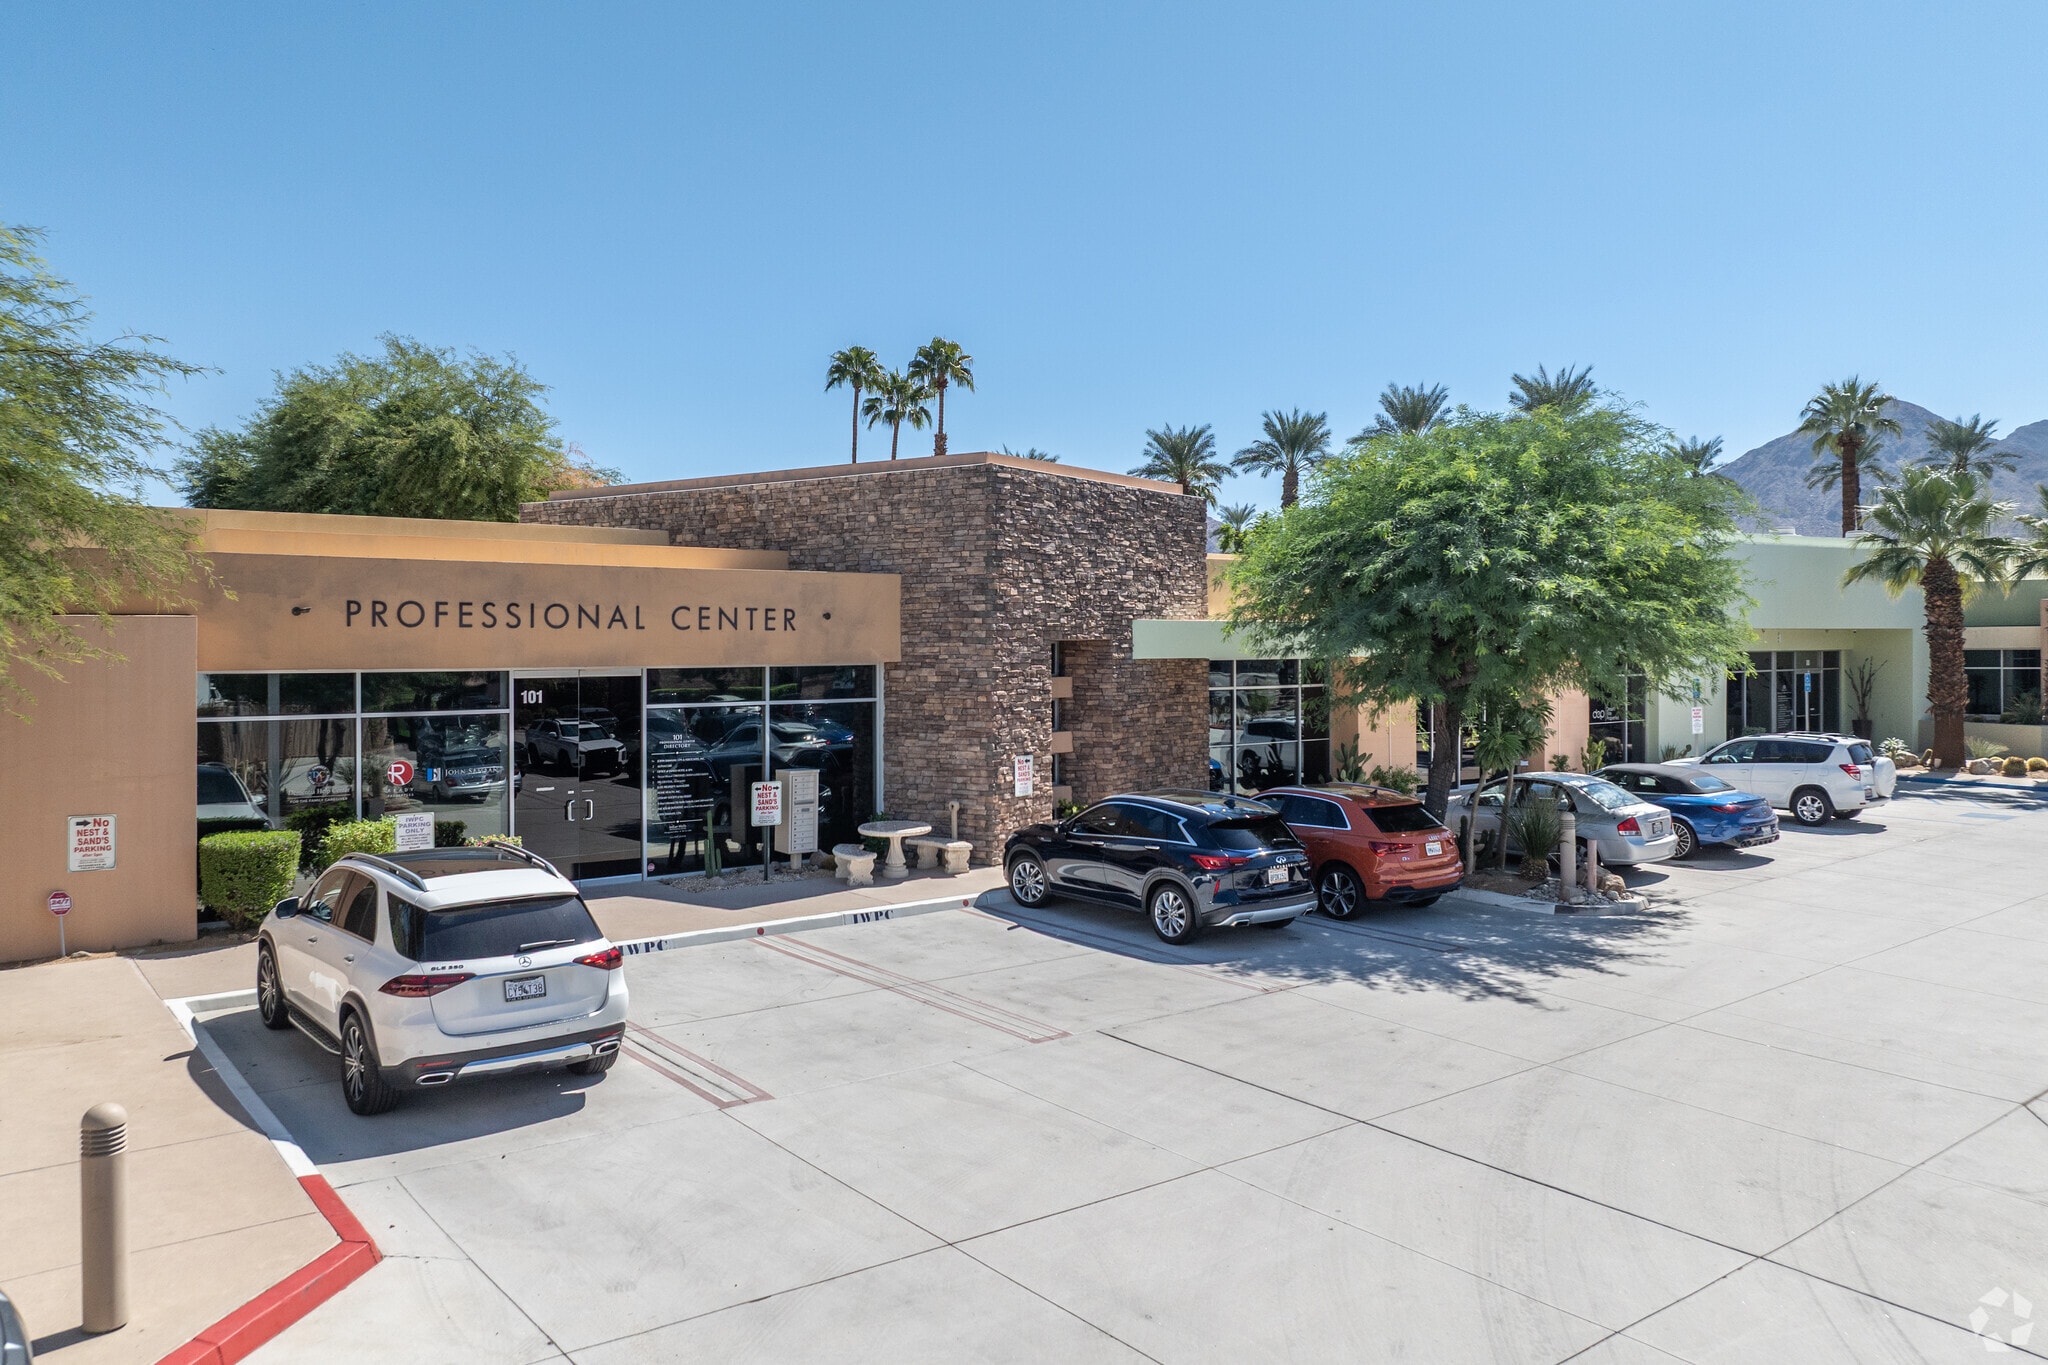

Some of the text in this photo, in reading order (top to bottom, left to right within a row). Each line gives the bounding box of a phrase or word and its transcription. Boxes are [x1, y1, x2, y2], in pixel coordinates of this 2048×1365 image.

[346, 600, 796, 632] PROFESSIONAL CENTER
[520, 690, 543, 704] 101
[445, 768, 466, 777] JOHN
[93, 817, 109, 827] No
[399, 821, 431, 829] PARKING
[77, 828, 109, 837] NEST &
[77, 837, 109, 846] SAND'S
[74, 845, 112, 853] PARKING
[853, 910, 894, 924] IWPC
[618, 940, 668, 956] IWPC
